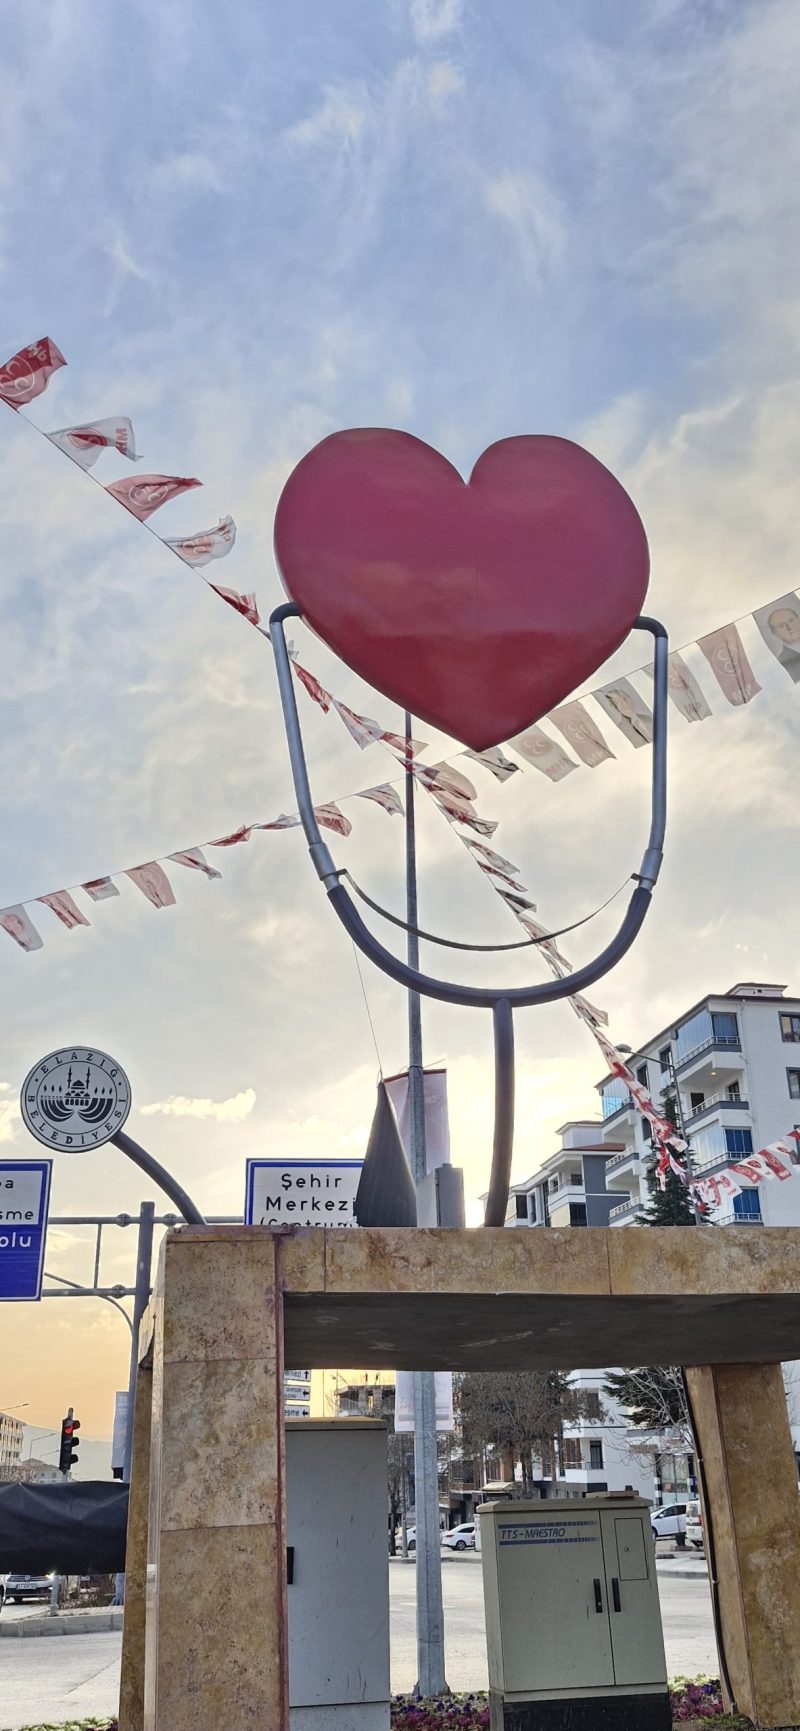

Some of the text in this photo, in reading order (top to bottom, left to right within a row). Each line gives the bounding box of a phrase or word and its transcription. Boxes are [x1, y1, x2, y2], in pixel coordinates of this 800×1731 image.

[281, 1173, 342, 1190] Şehir
[266, 1196, 356, 1211] Merkez
[501, 1528, 566, 1540] TTS-MAESTRO
